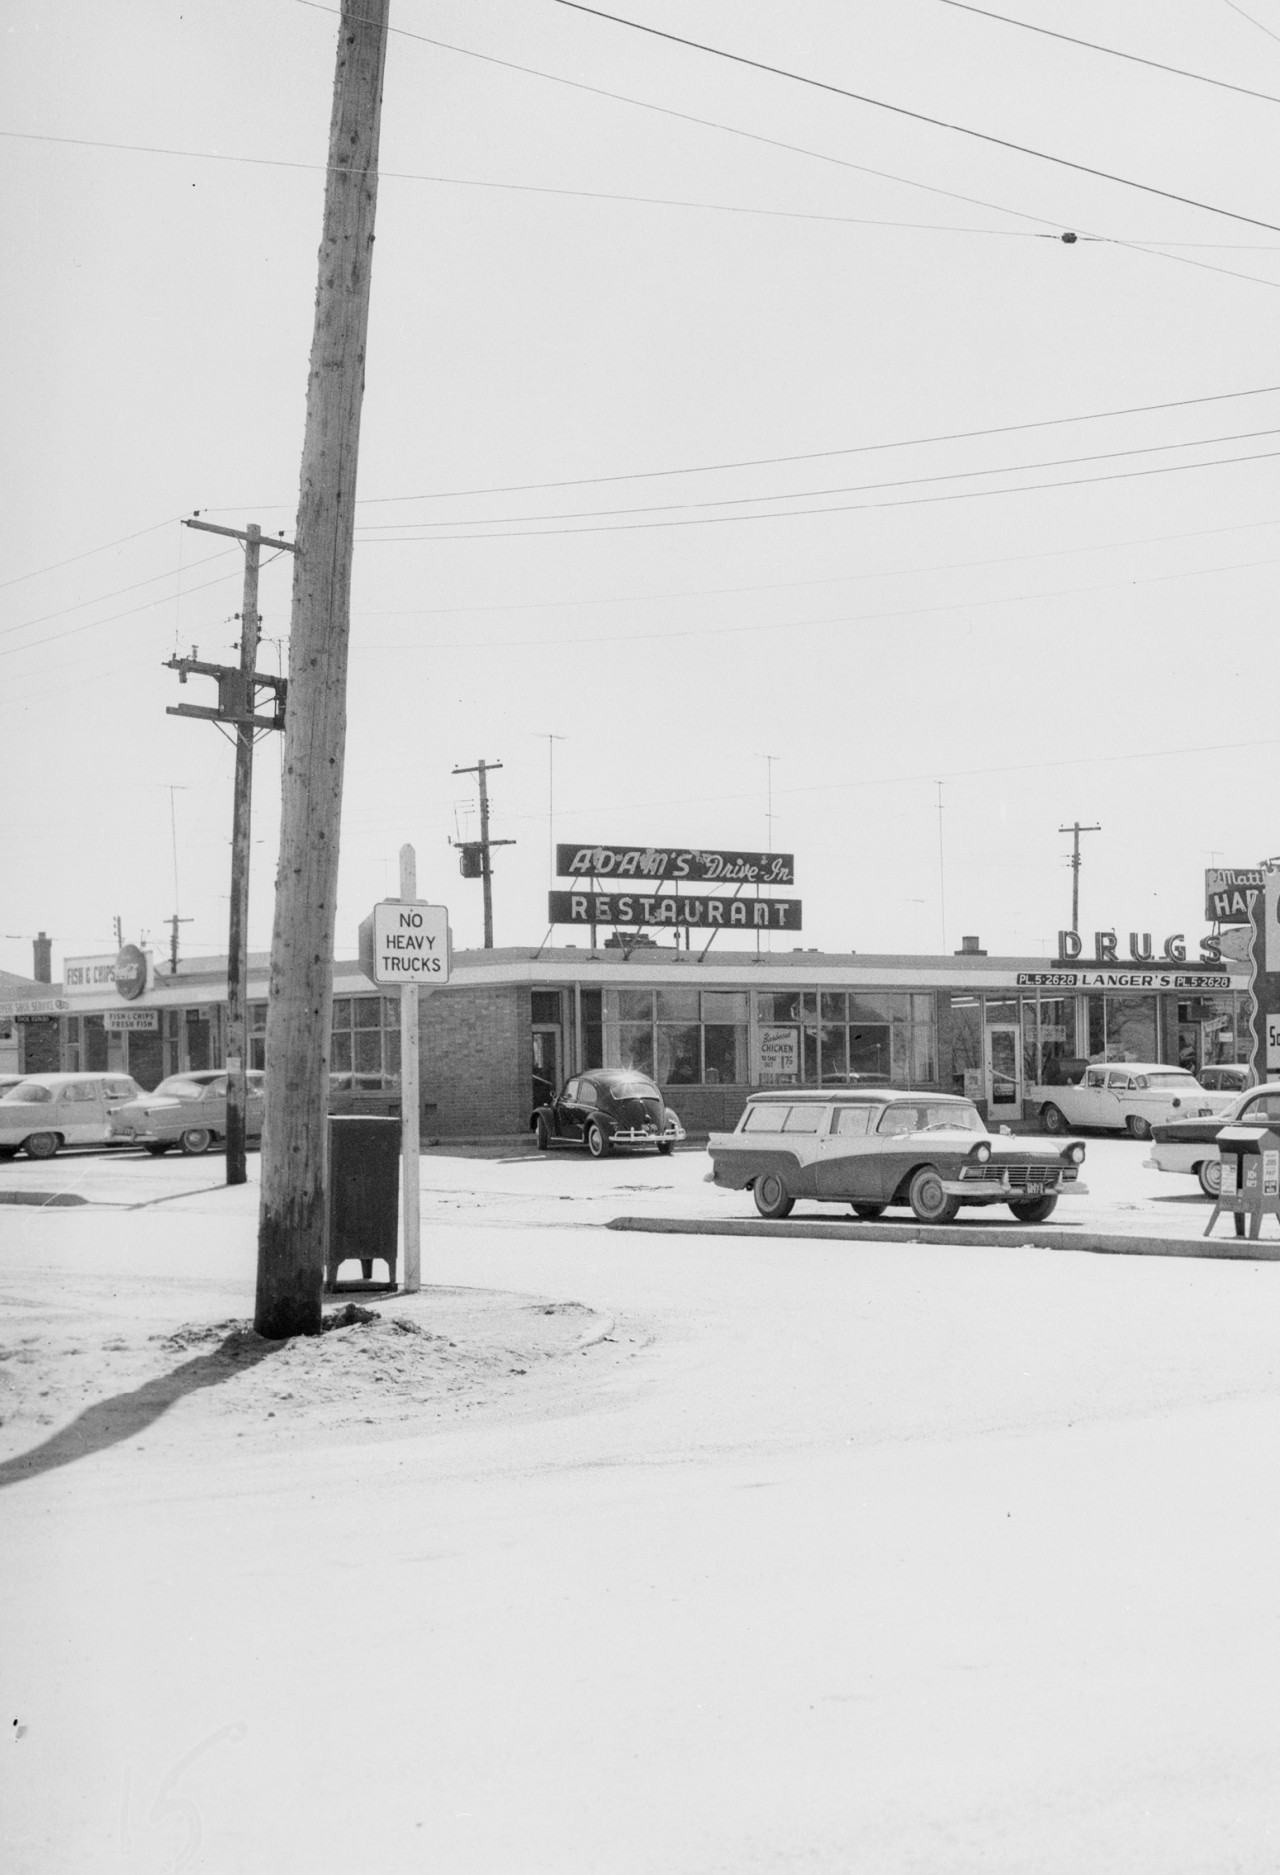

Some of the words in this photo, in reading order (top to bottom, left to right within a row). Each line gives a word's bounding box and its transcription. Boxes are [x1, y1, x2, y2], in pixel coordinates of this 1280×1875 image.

[568, 849, 692, 877] ADAM'S
[571, 895, 790, 926] RESTAURANT
[399, 912, 423, 928] NO
[386, 934, 436, 950] HEAVY
[1058, 930, 1222, 964] DRUGS
[382, 956, 441, 972] TRUCKS
[67, 967, 83, 986] FISH
[93, 964, 116, 984] CHIPS
[1082, 974, 1171, 987] LANGER'S
[109, 1012, 126, 1020] FISH
[132, 1012, 155, 1020] CHIPS
[111, 1020, 134, 1028] FRESH
[136, 1020, 153, 1028] FISH
[761, 1043, 794, 1054] CHICKEN
